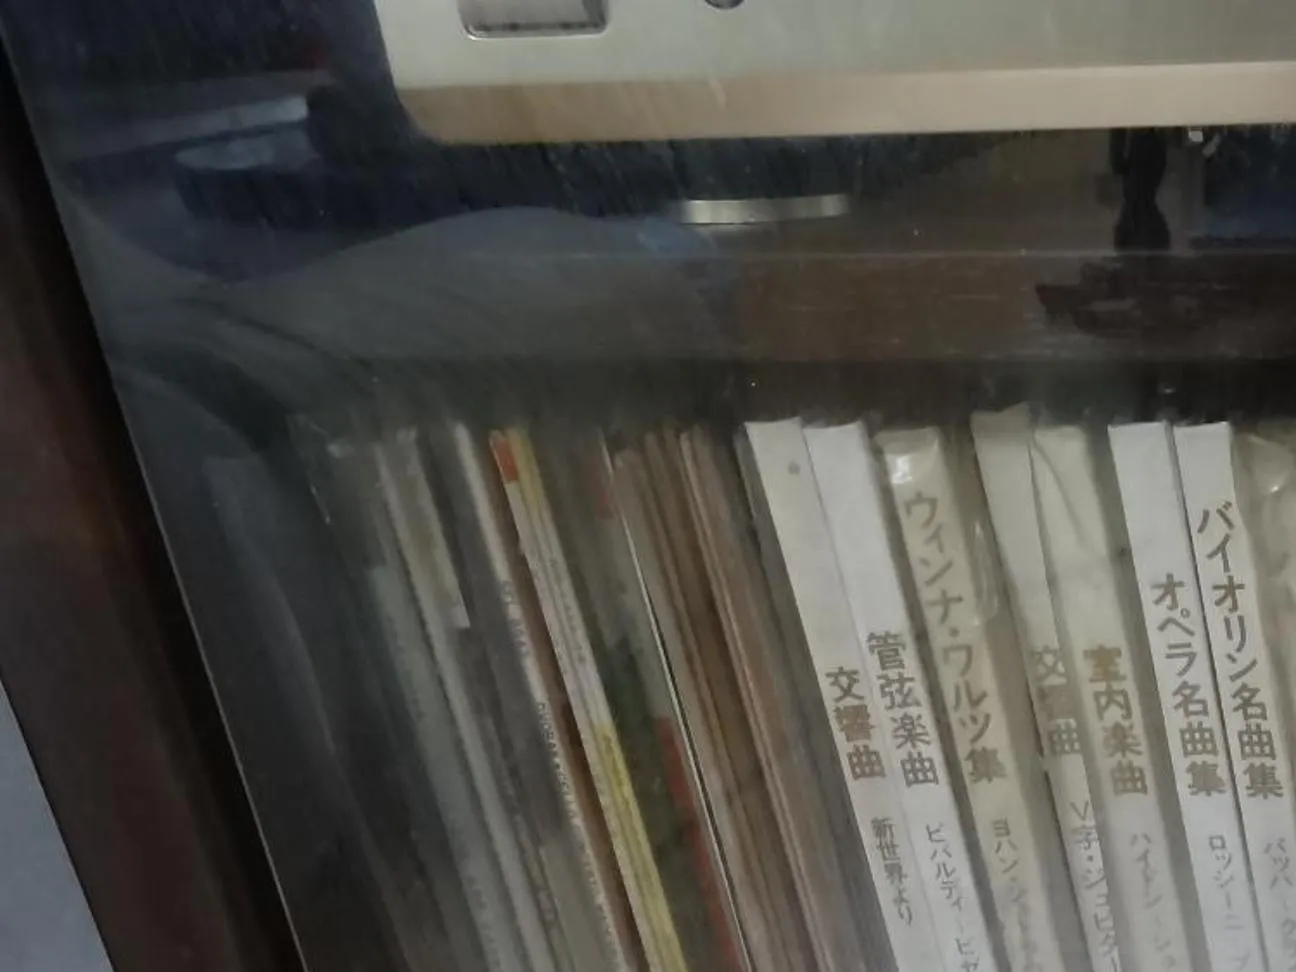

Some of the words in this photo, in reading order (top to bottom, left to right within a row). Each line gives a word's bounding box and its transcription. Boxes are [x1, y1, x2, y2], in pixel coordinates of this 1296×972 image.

[868, 631, 940, 787] 管弦楽曲
[905, 491, 1007, 783] ウィンナ・ワルツ集
[1032, 645, 1082, 755] 交曲
[1152, 573, 1227, 797] オペラ名曲集
[1197, 501, 1283, 799] バイオリン名曲集
[826, 666, 887, 781] 交響曲
[1082, 643, 1149, 796] 室内楽曲
